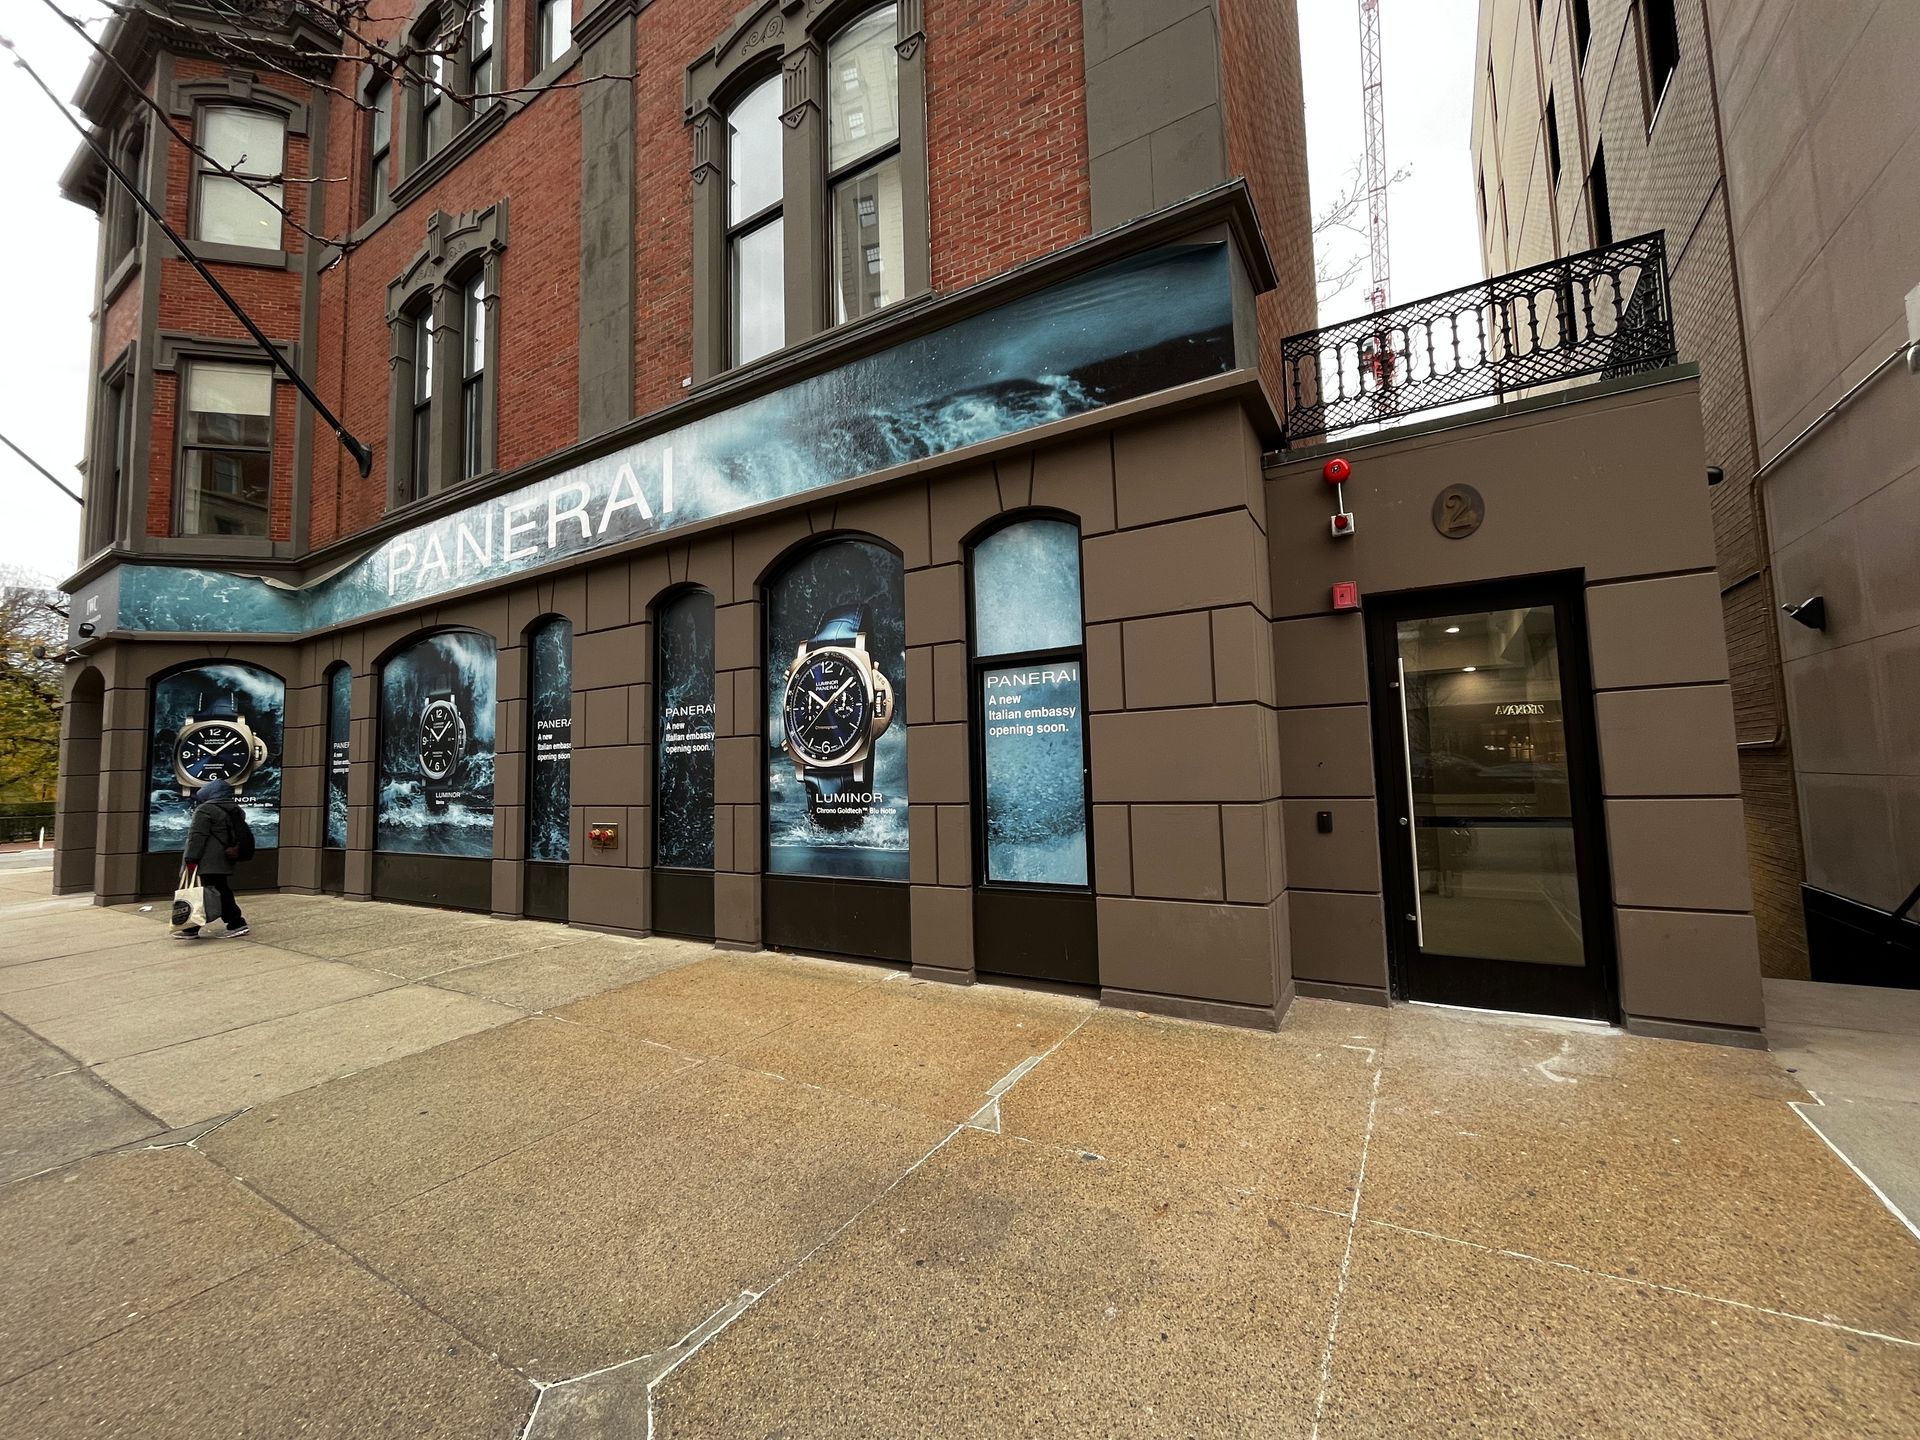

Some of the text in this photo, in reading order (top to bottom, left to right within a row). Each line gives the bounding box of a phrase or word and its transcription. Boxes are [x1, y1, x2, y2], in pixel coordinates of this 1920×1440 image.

[1444, 491, 1474, 531] 2
[388, 447, 674, 596] PANERAI
[820, 661, 834, 674] 12
[987, 668, 1077, 689] PANERAI
[988, 695, 1022, 706] A new
[665, 703, 716, 718] PANERAI
[988, 706, 1077, 721] Italian embassy
[665, 721, 686, 731] A new
[989, 723, 1069, 738] opening soon.
[209, 728, 222, 736] 12
[685, 731, 716, 741] embassy
[665, 744, 692, 755] opening
[821, 740, 832, 754] 6
[182, 750, 192, 759] 9
[434, 761, 441, 771] 6
[208, 772, 218, 781] 6
[435, 791, 461, 799] LUMINOR
[815, 792, 883, 803] LUMINOR
